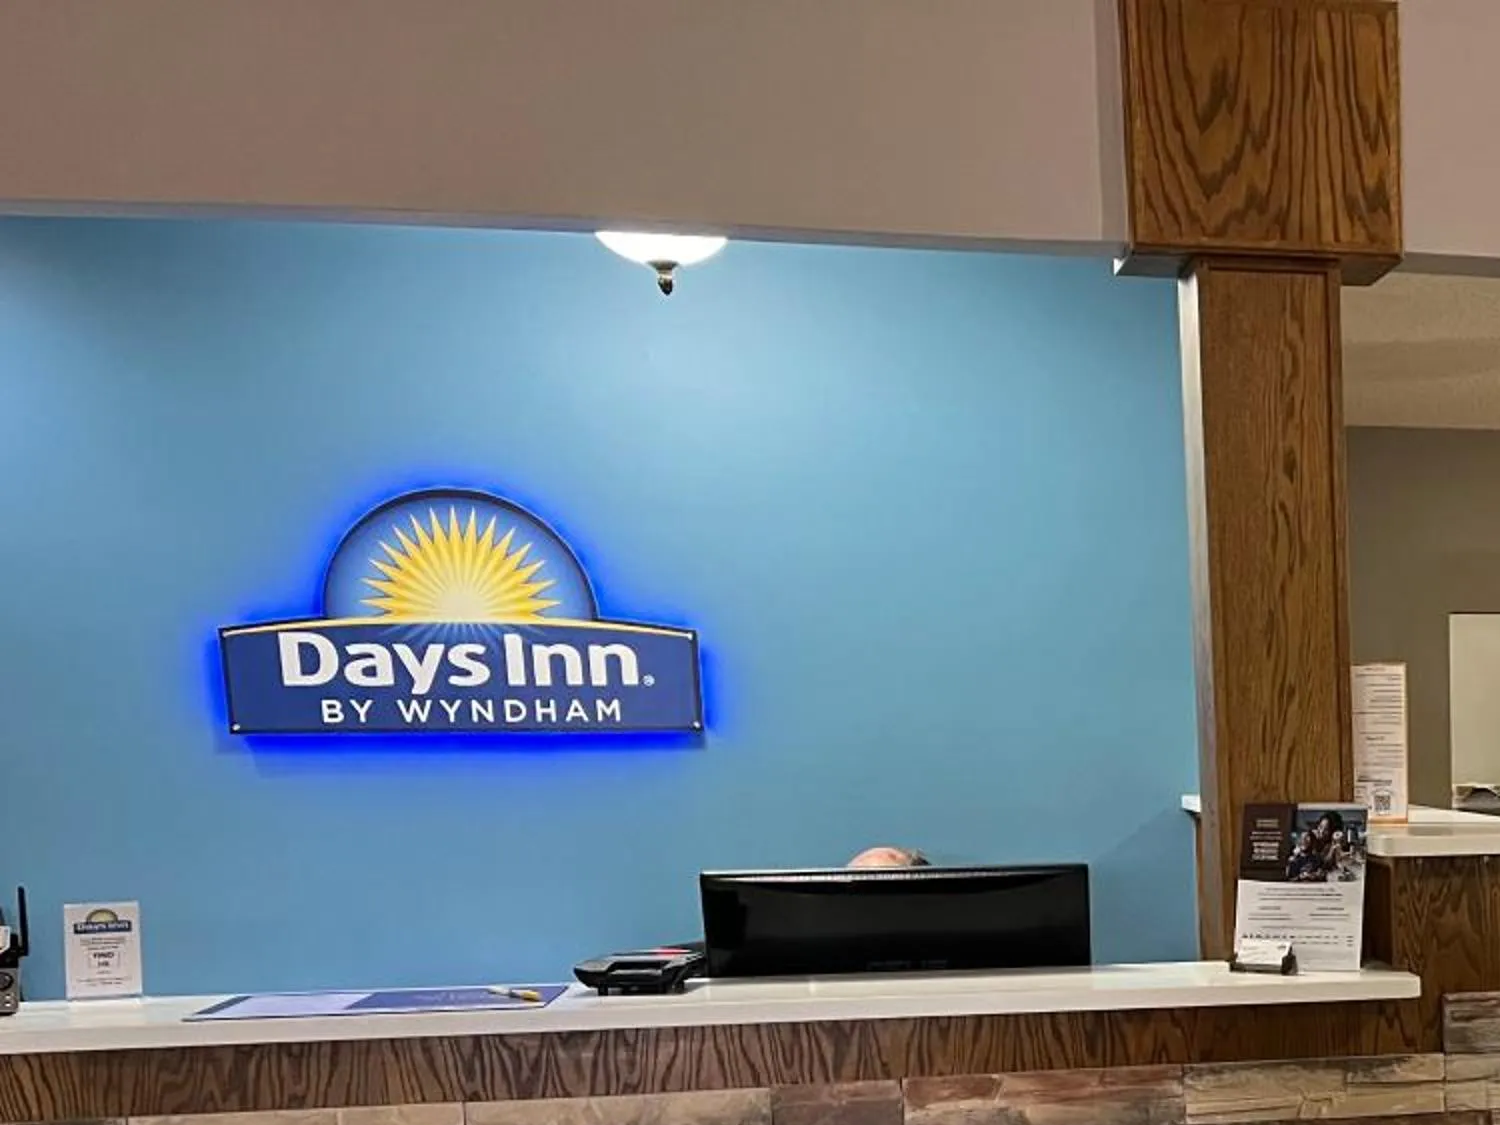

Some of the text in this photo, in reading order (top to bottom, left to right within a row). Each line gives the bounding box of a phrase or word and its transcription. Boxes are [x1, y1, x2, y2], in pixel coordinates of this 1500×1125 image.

[277, 631, 639, 695] Days Inn
[321, 698, 622, 724] BY WYNDHAM
